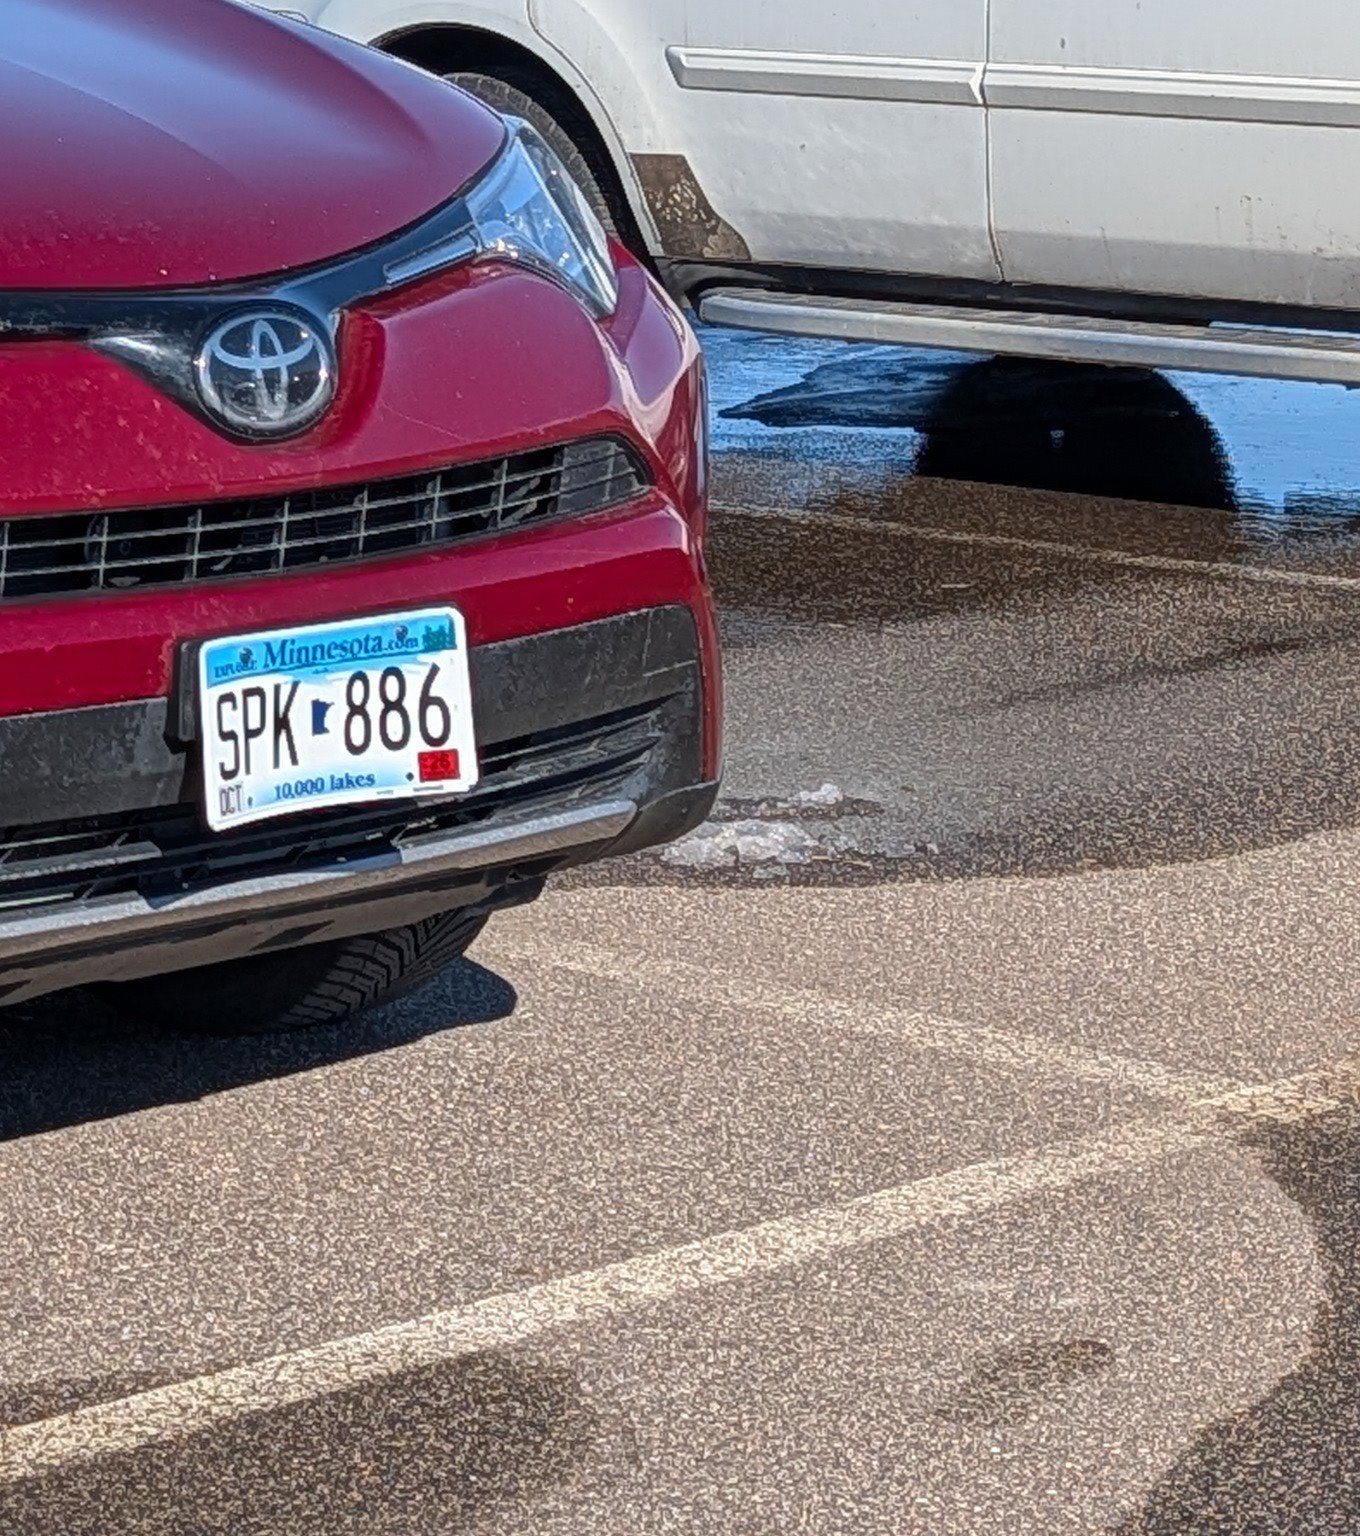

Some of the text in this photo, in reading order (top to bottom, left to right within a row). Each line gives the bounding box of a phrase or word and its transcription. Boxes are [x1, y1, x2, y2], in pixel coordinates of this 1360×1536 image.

[216, 662, 451, 781] SPK 886
[275, 772, 376, 800] 10,000 lakes
